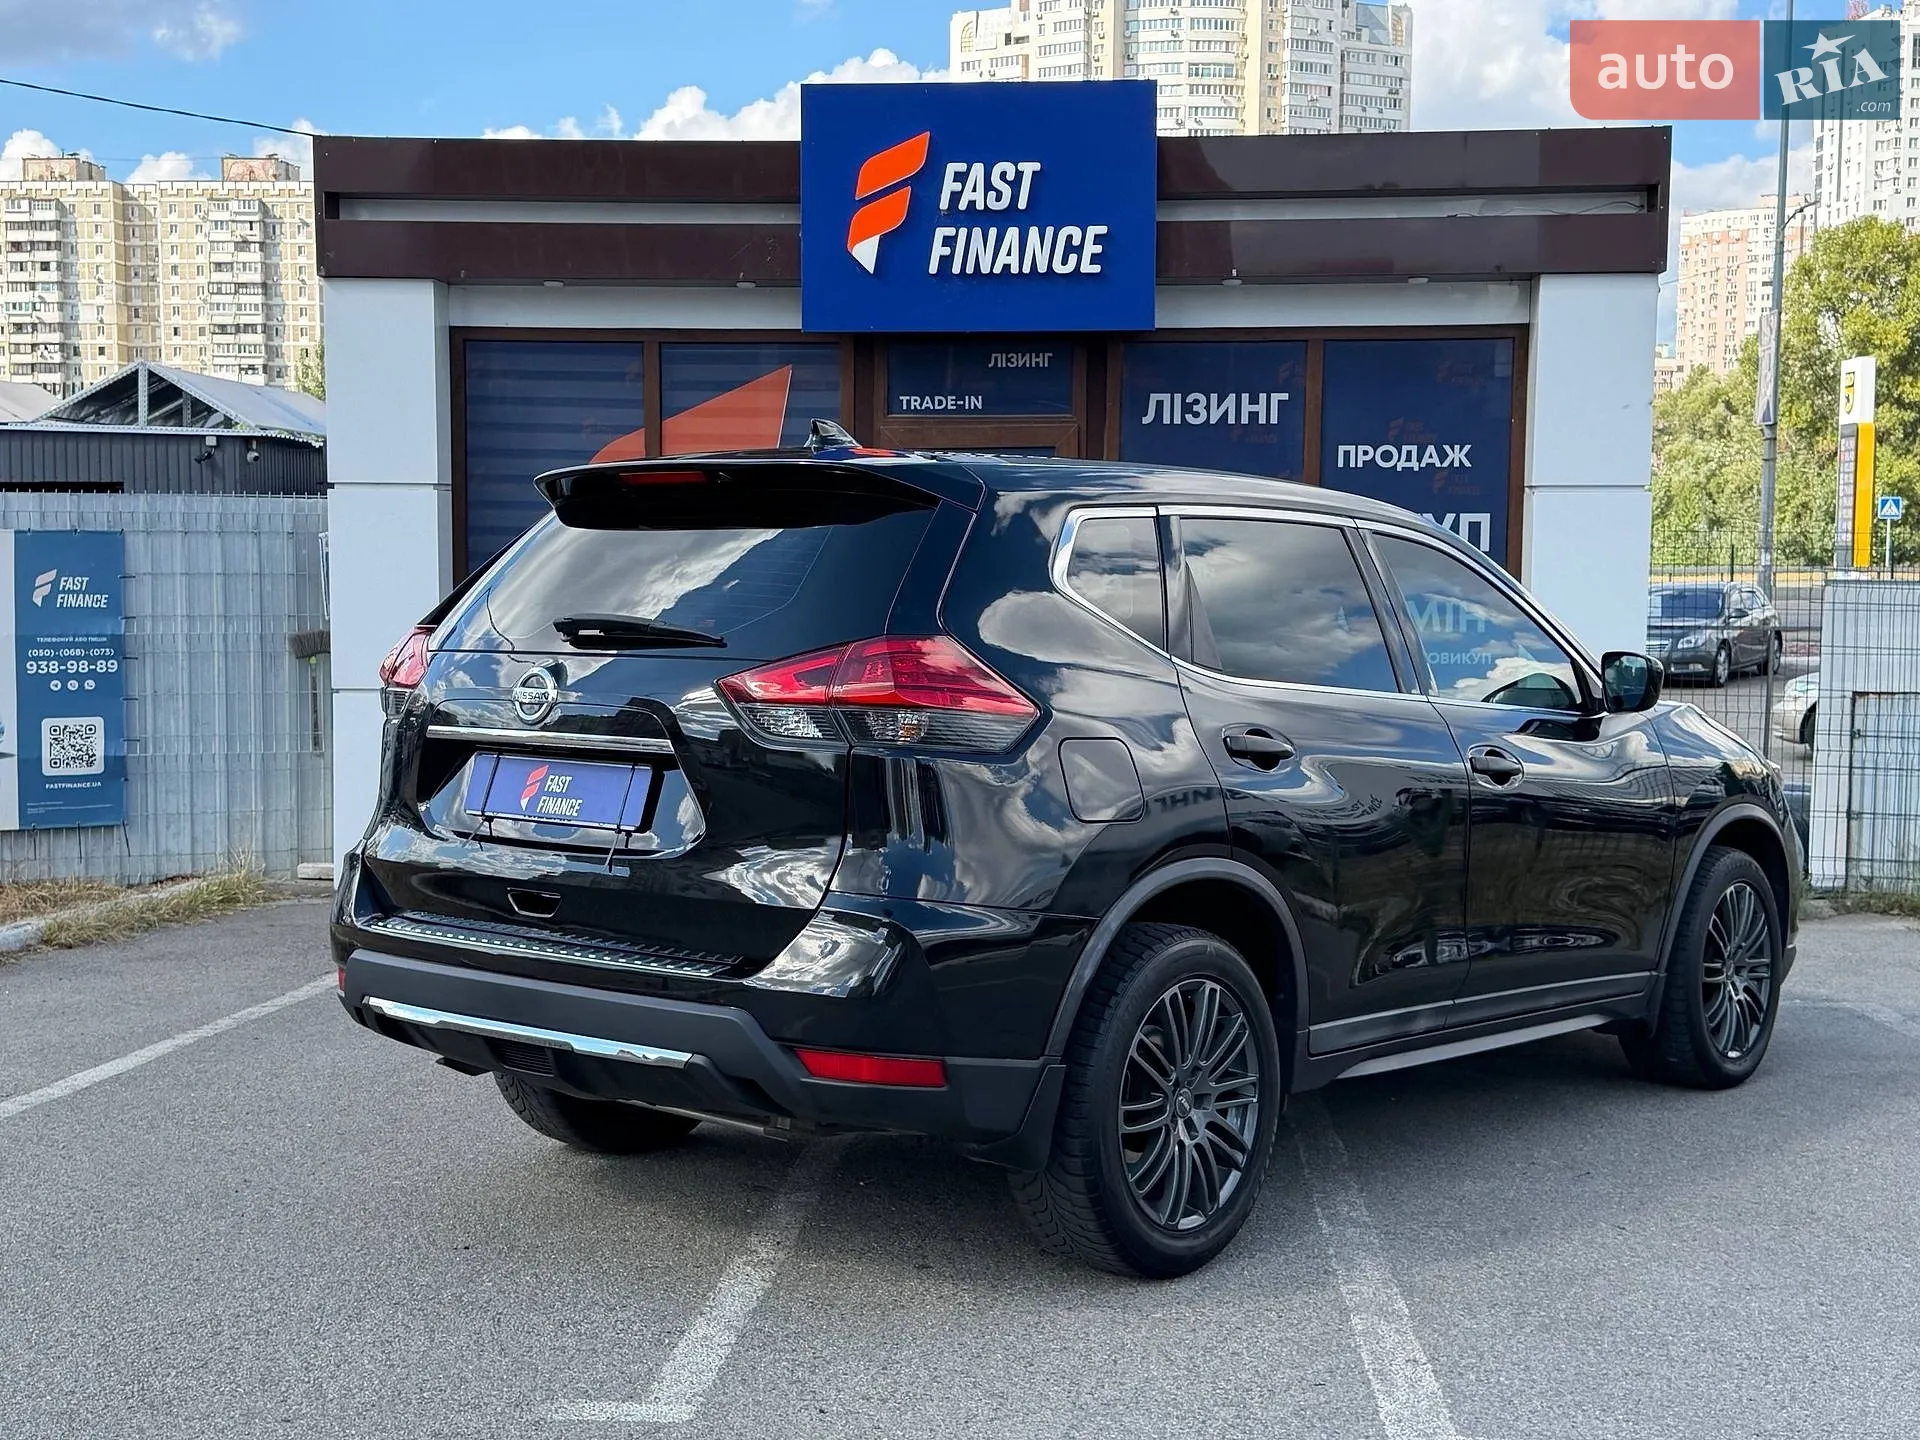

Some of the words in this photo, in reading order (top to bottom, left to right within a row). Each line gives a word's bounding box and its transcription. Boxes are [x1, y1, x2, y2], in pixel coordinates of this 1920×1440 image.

[939, 161, 1041, 211] FAST
[928, 225, 1109, 275] FINANCE
[988, 352, 1053, 368] ЛІЗИНГ
[899, 395, 983, 410] TRADE-IN
[1141, 392, 1289, 425] ЛІЗИНГ
[1337, 444, 1473, 472] ПРОДАЖ
[59, 576, 90, 591] FAST
[56, 593, 109, 608] FINANCE
[25, 659, 119, 675] 938-98-89
[514, 689, 550, 701] NISSAN
[545, 774, 573, 793] FAST
[536, 796, 584, 817] FINANCE
